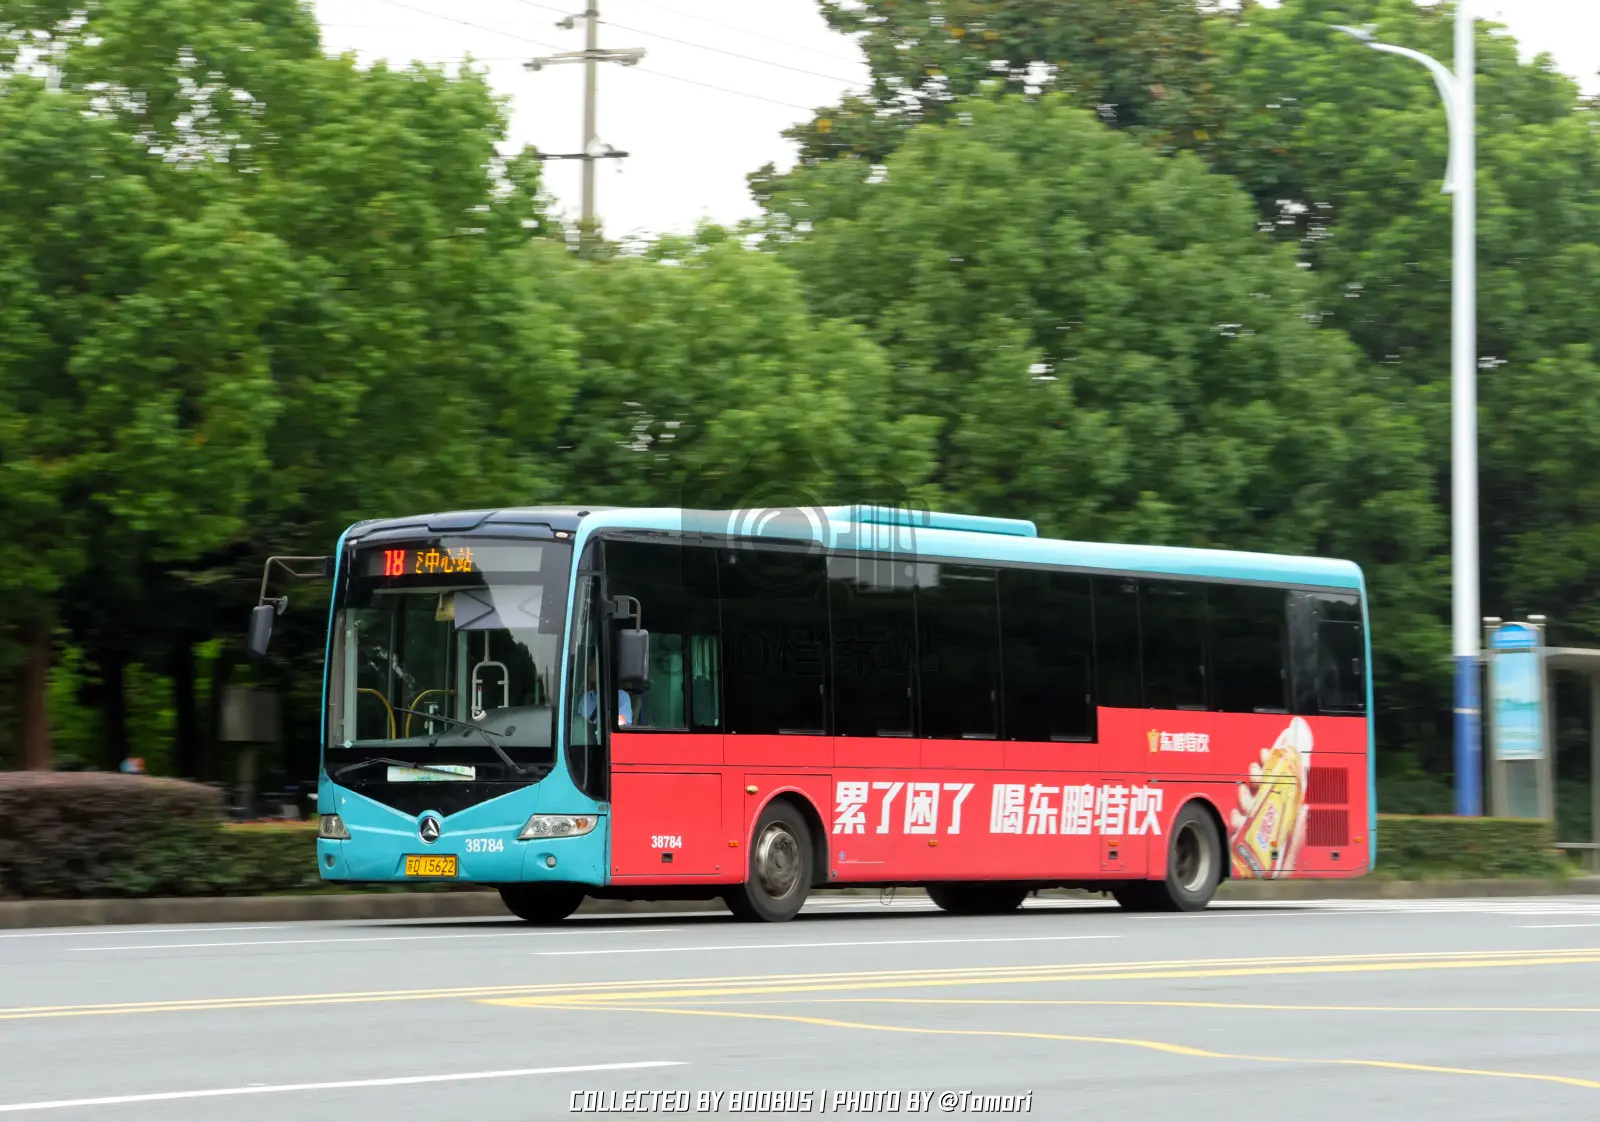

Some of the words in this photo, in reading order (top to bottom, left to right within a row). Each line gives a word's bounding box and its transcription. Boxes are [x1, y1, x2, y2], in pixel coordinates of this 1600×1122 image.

[384, 549, 405, 576] 18
[832, 781, 975, 834] 累了困了
[989, 784, 1163, 835] 喝东鹏特饮
[465, 838, 504, 853] 38784
[651, 835, 683, 849] 38784
